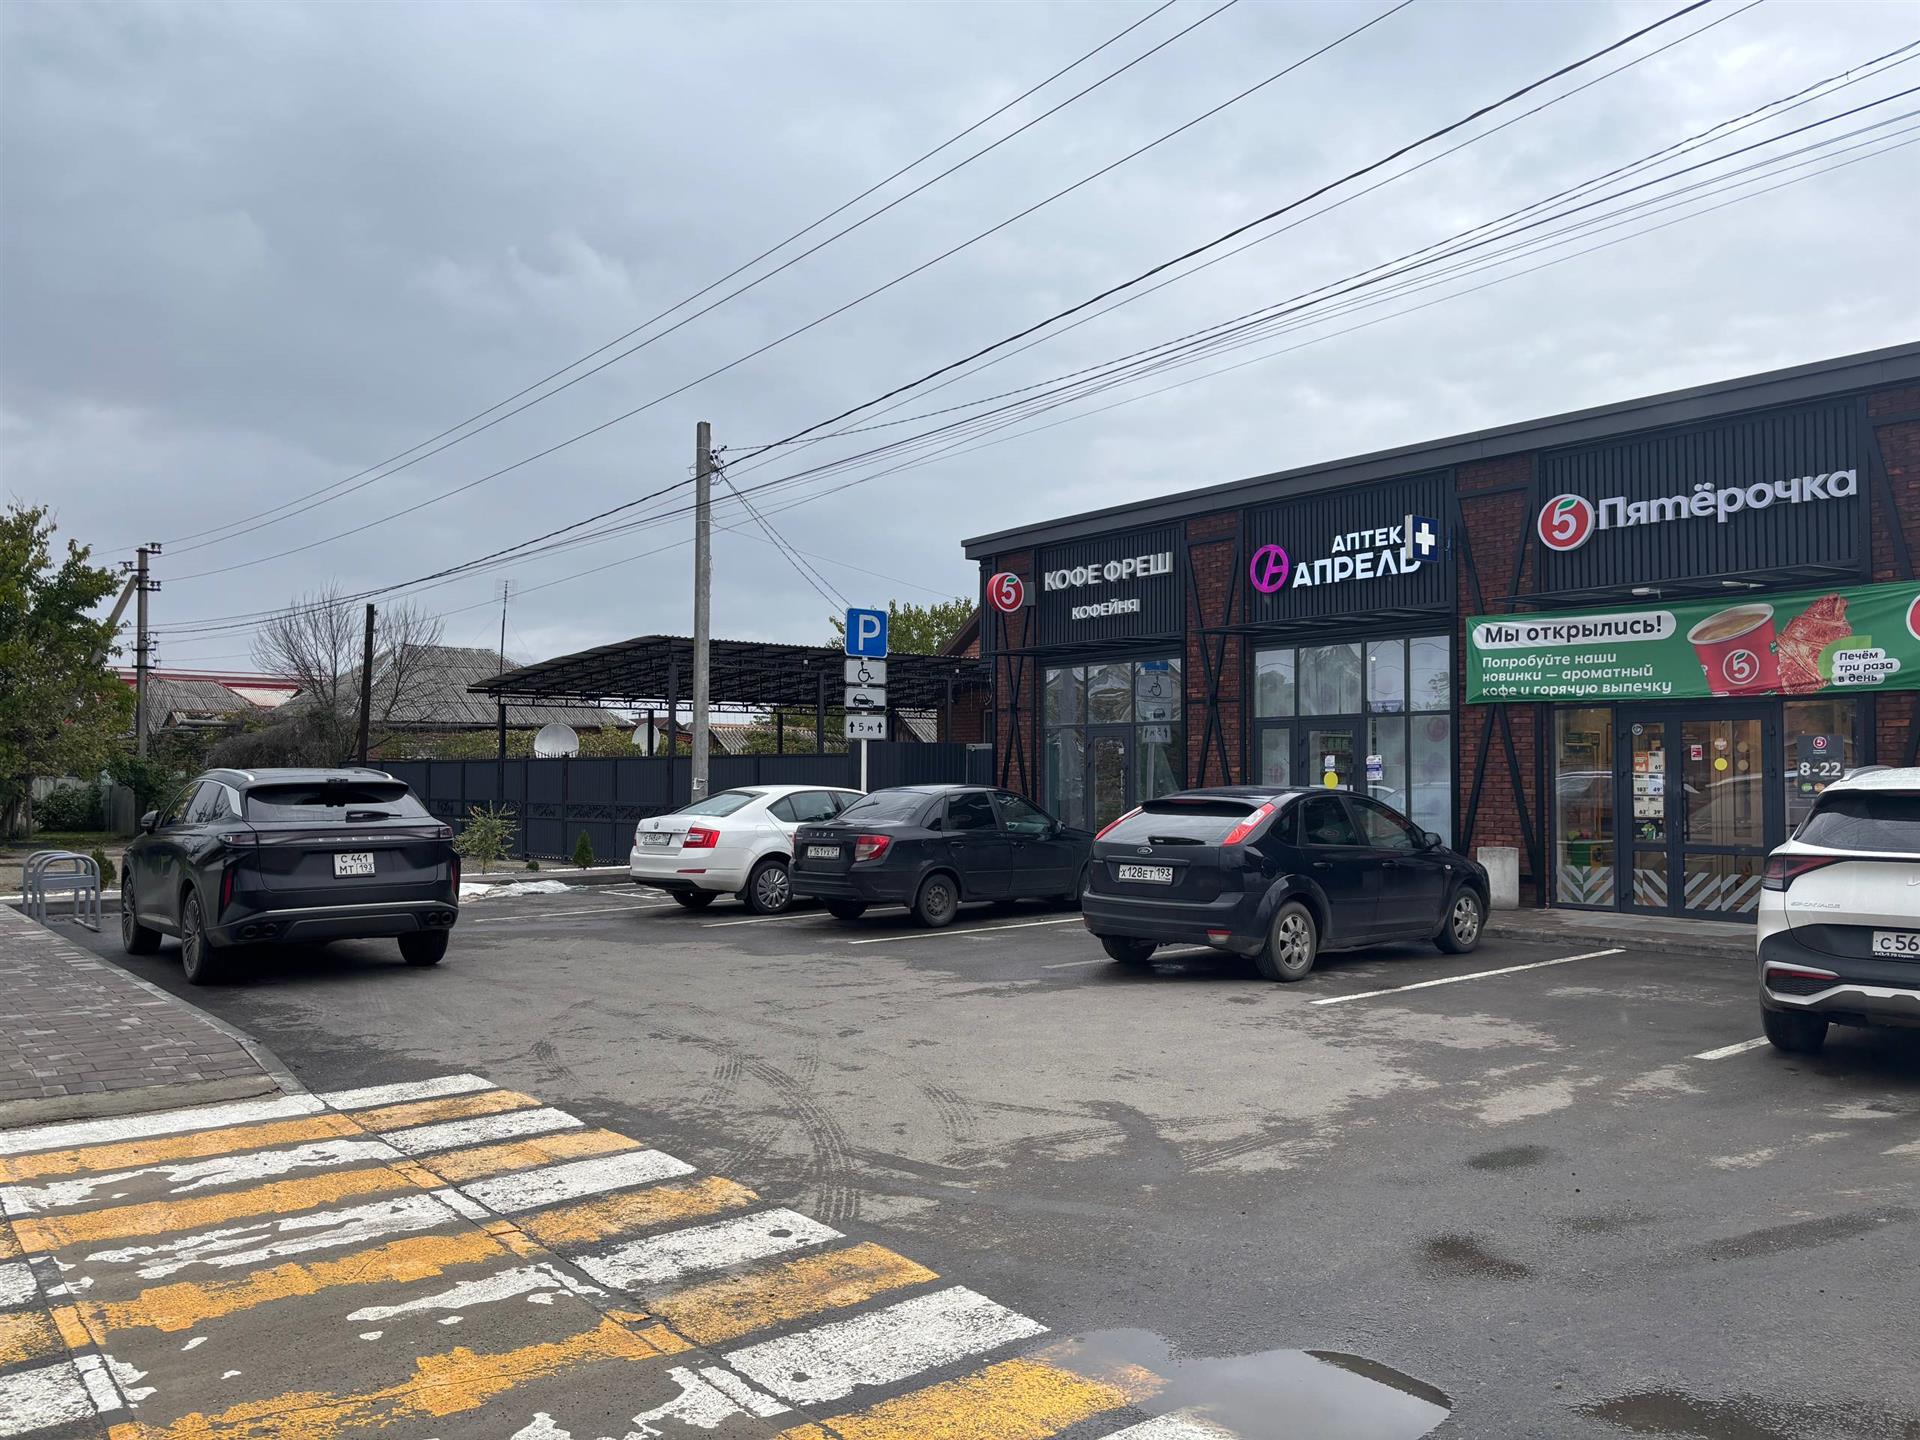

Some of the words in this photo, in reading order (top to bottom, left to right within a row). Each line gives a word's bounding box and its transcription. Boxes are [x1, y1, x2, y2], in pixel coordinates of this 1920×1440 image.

[1598, 469, 1857, 530] Пятёрочка
[1552, 500, 1578, 540] 5
[1331, 525, 1406, 553] АПТЕК
[1045, 563, 1102, 591] КОФЕ
[1103, 552, 1174, 582] ФРЕШ
[1001, 576, 1016, 604] 5
[1072, 598, 1141, 620] КОФЕЙНЯ
[858, 614, 881, 651] P
[1485, 626, 1519, 643] Мы
[1526, 615, 1662, 643] открылись!
[1482, 654, 1571, 670] Попробуйте
[1575, 652, 1617, 665] наши
[1839, 651, 1879, 661] Печём
[1482, 671, 1542, 682] новинки
[1562, 664, 1653, 682] ароматный
[1732, 652, 1750, 679] 5
[1838, 663, 1861, 674] три
[1863, 662, 1893, 673] раза
[1848, 673, 1878, 683] день
[1482, 684, 1517, 698] кофе
[1520, 686, 1529, 695] и
[1533, 684, 1598, 697] горячую
[1602, 681, 1672, 695] выпечку
[858, 723, 864, 732] 5
[1800, 762, 1841, 776] 8-22
[351, 854, 368, 863] 441
[339, 865, 354, 874] МТ
